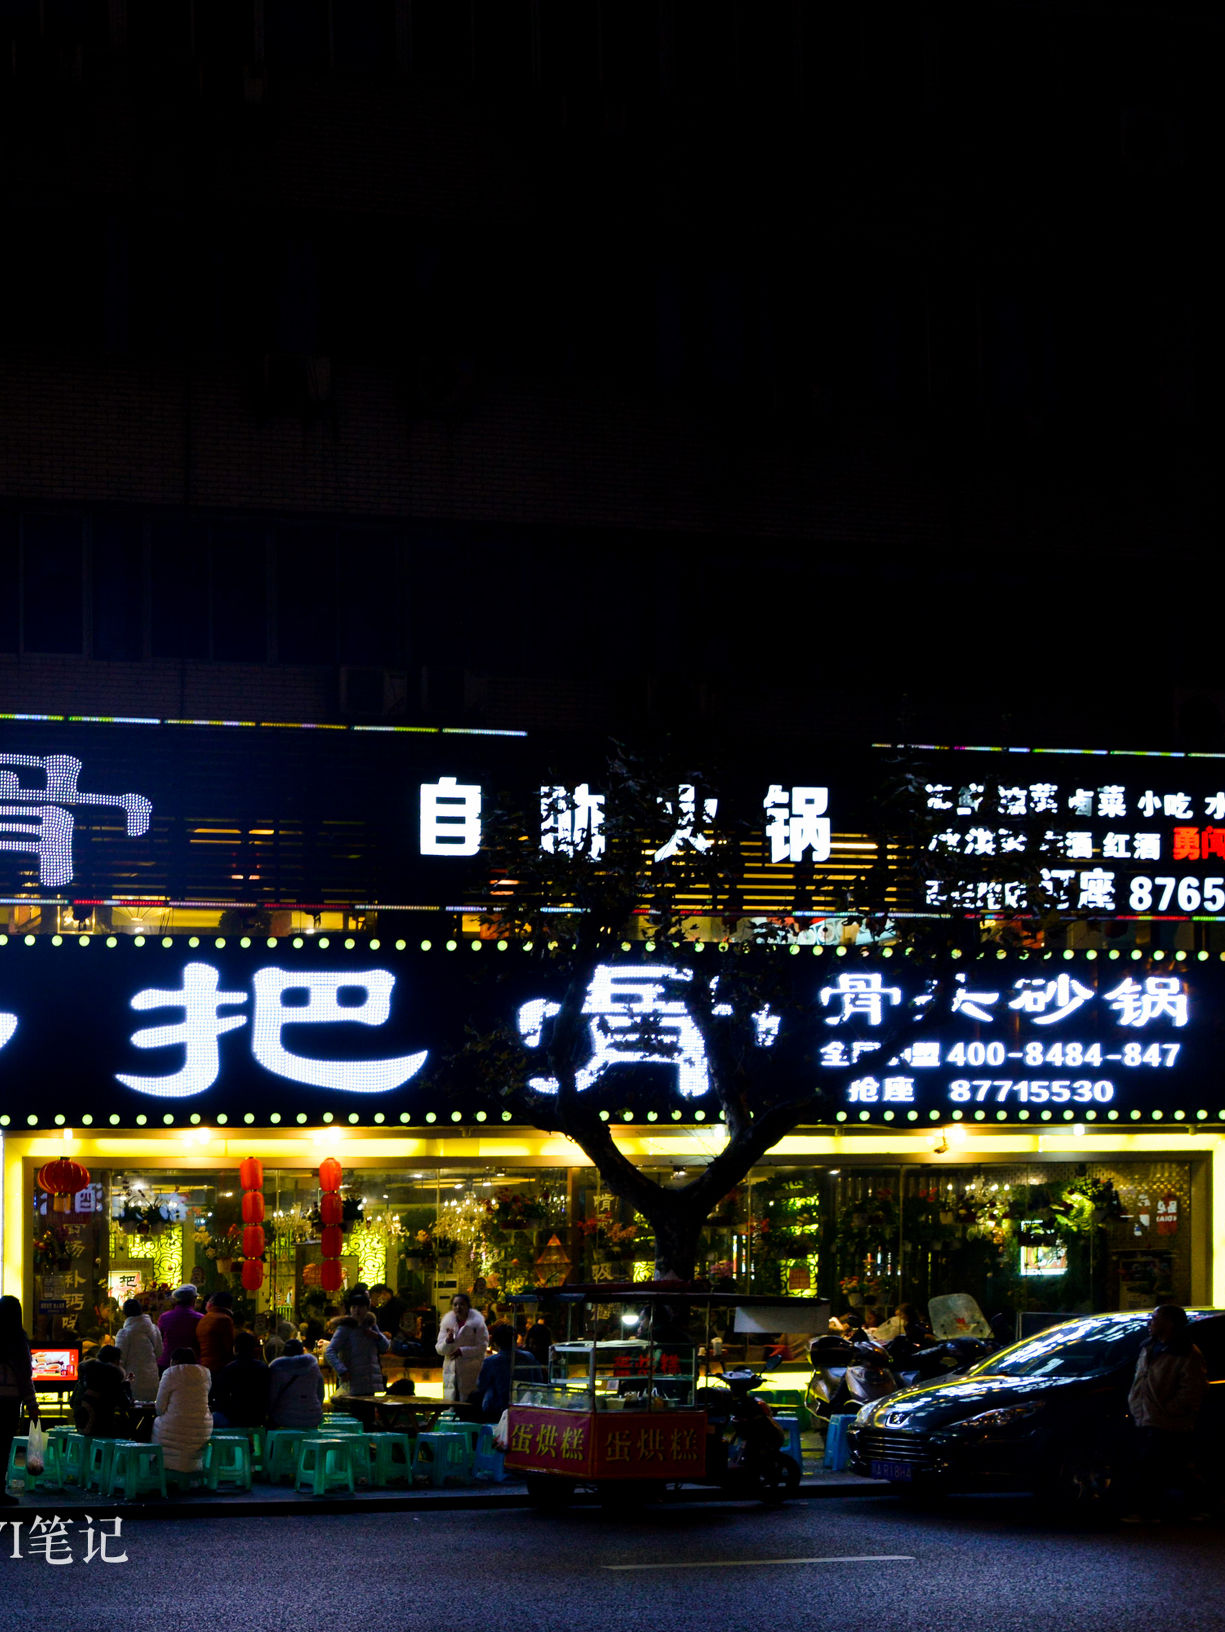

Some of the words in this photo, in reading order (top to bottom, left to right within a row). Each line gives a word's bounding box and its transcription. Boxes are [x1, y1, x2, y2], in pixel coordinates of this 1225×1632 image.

[1137, 790, 1194, 819] 小吃
[1102, 832, 1161, 861] 红酒
[1128, 875, 1225, 912] 8765
[946, 1041, 1181, 1068] 400-8484-847
[848, 1076, 915, 1103] 抢座
[950, 1080, 1115, 1103] 87715530
[511, 1423, 585, 1461] 蛋烘糕
[604, 1428, 699, 1463] 蛋烘糕
